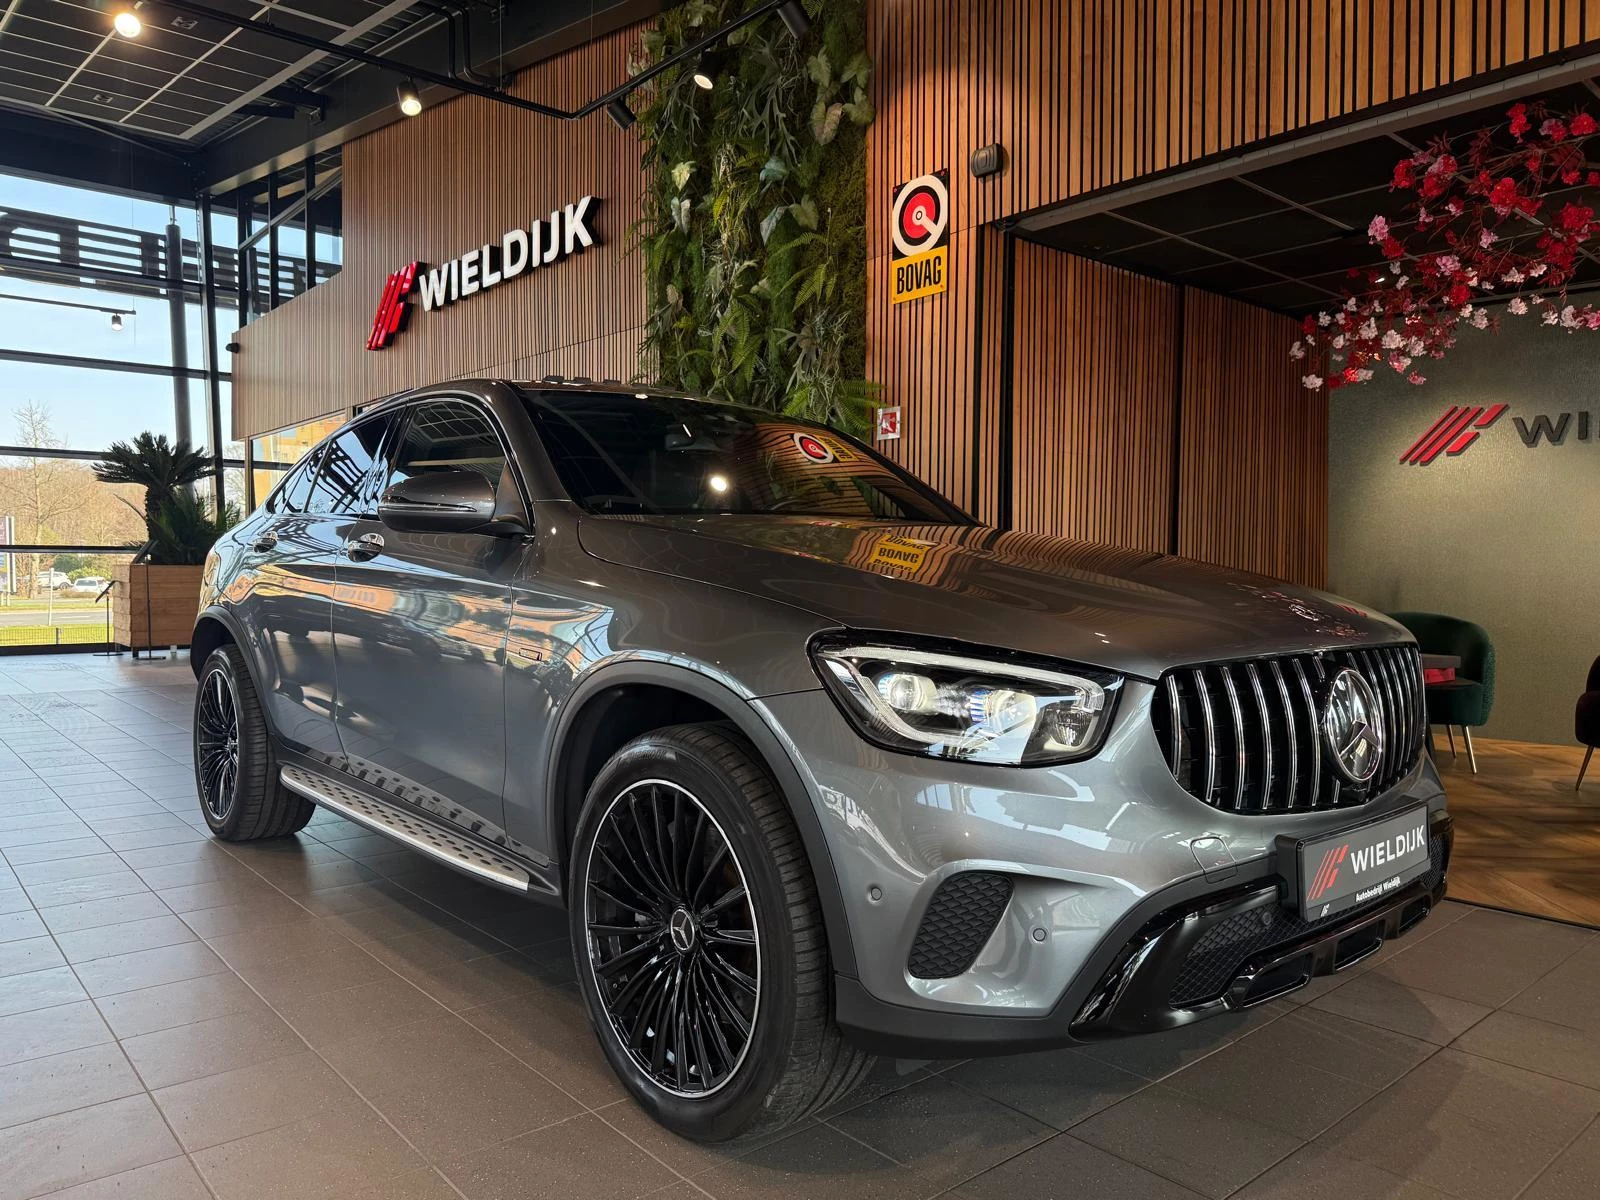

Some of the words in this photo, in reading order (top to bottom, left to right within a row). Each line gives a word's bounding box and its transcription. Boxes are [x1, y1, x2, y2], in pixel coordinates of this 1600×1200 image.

[419, 195, 593, 312] WIELDIJK
[896, 255, 942, 295] BOVAG
[1512, 411, 1600, 443] WI
[1351, 825, 1425, 874] WIELDIJK
